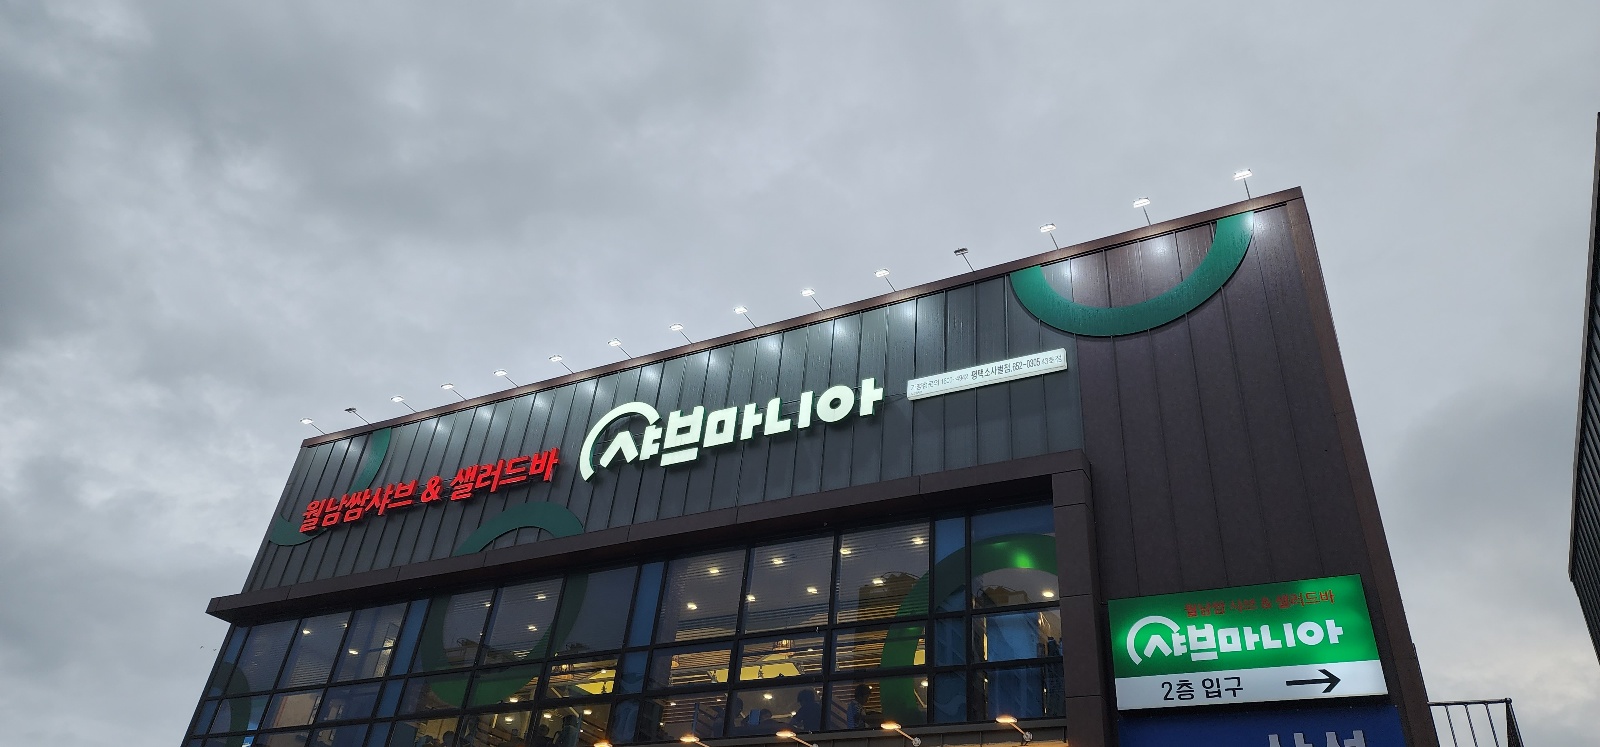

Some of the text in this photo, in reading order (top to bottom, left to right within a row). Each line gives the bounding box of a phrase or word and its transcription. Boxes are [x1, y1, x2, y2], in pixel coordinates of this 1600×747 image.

[599, 377, 884, 467] 샤브마니아
[299, 447, 560, 533] 월남쌈샤브 & 샐러드바
[1276, 589, 1335, 609] 샐러드바
[1143, 619, 1344, 662] 샤브마니아
[1161, 676, 1244, 701] 2층 입구
